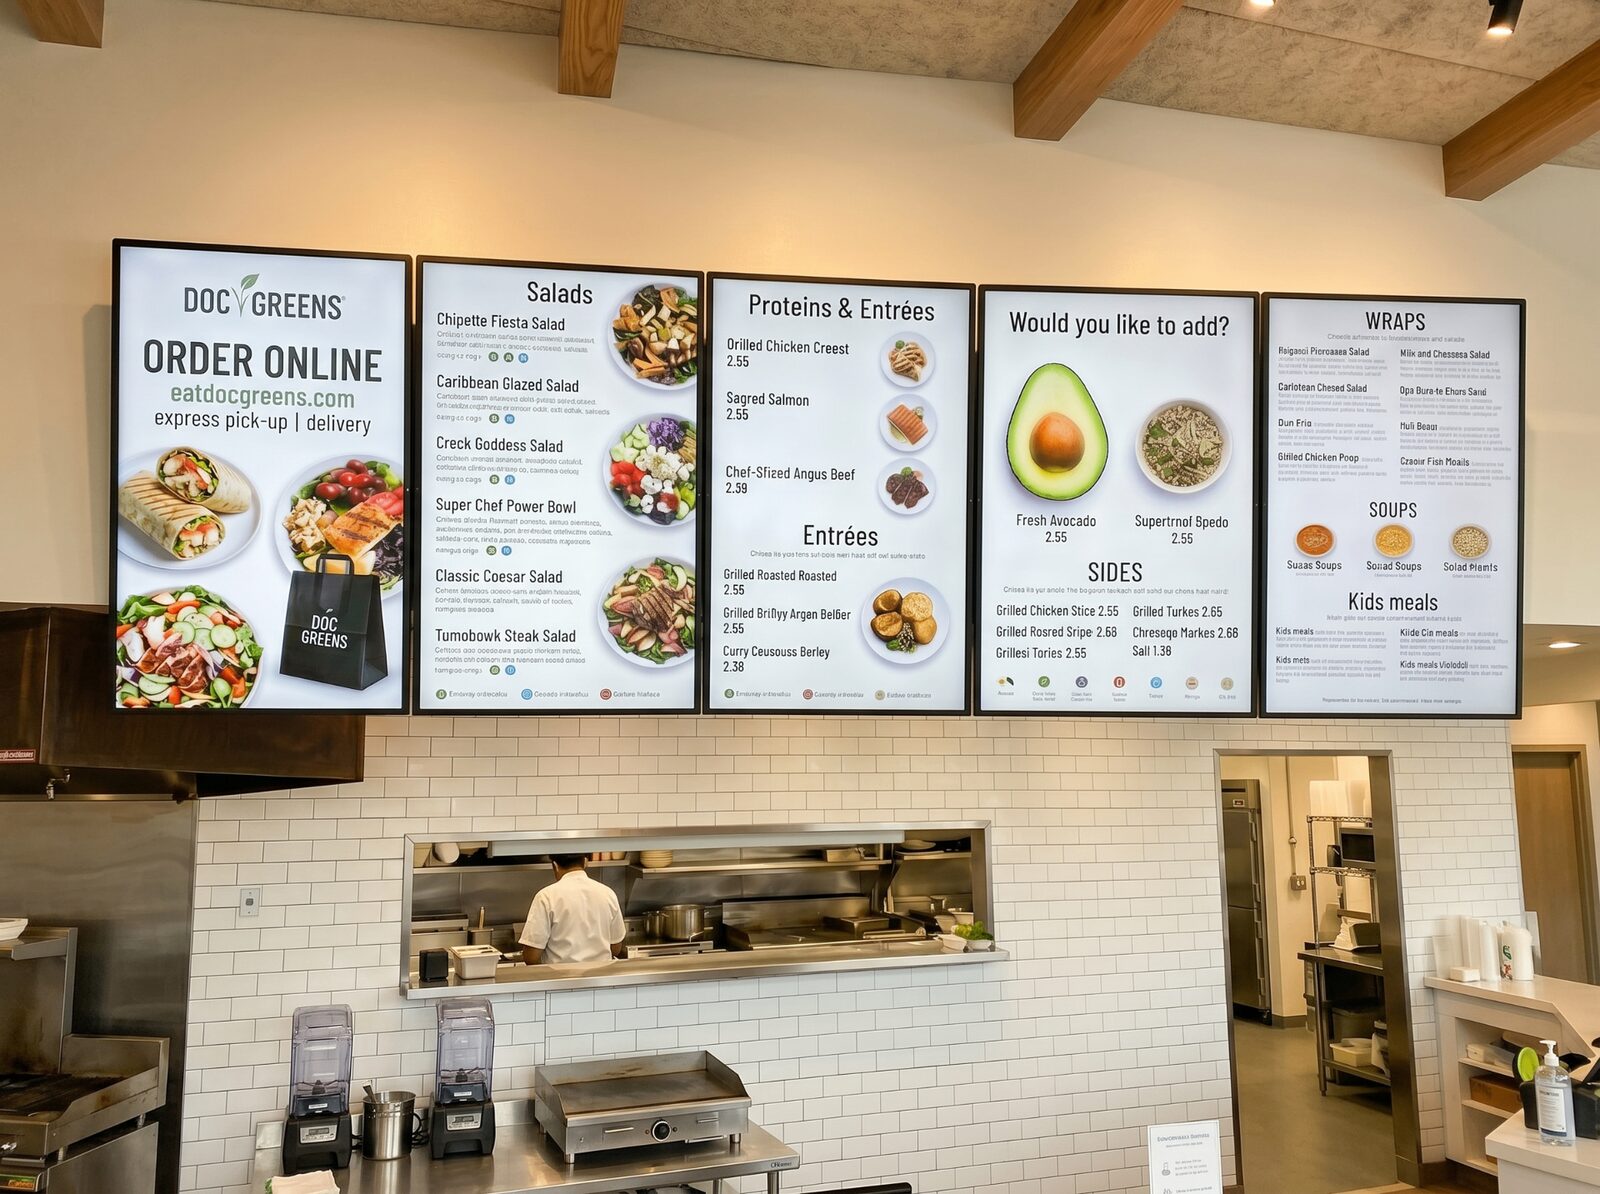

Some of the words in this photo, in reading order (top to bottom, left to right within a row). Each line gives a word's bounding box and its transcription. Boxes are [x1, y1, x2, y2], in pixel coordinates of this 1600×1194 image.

[527, 280, 593, 305] Salads
[184, 286, 231, 315] DOC
[749, 293, 832, 318] Proteins
[838, 297, 853, 319] &
[860, 298, 935, 322] Entrées
[437, 311, 488, 330] Chipette
[491, 314, 529, 330] Fiesta
[531, 316, 565, 331] Salad
[1009, 311, 1069, 333] Would
[1075, 318, 1110, 339] you
[1116, 313, 1151, 335] like
[1156, 316, 1176, 336] to
[1182, 315, 1230, 337] add?
[1365, 311, 1426, 331] WRAPS
[766, 339, 810, 354] Chicken
[813, 341, 850, 355] Creest
[1348, 346, 1370, 357] Salad
[143, 338, 253, 378] ORDER
[264, 344, 383, 383] ONLINE
[726, 354, 750, 368] 2.55
[1417, 349, 1432, 359] and
[1469, 350, 1491, 360] Salad
[436, 374, 499, 390] Caribbean
[502, 376, 543, 392] Glazed
[546, 378, 579, 393] Salad
[1346, 383, 1368, 393] Salad
[170, 383, 355, 410] eatdocgreens.com
[726, 391, 766, 408] Sagred
[768, 392, 810, 407] Salmon
[726, 407, 749, 421] 2.55
[154, 412, 220, 430] express
[225, 410, 288, 434] pick-up
[306, 413, 372, 438] delivery
[436, 435, 472, 450] Creck
[475, 436, 527, 452] Goddess
[530, 438, 563, 453] Salad
[1304, 452, 1338, 462] Chicken
[793, 467, 828, 483] Angus
[830, 467, 856, 481] Beef
[725, 481, 748, 494] 2.59
[436, 497, 473, 515] Super
[475, 498, 503, 512] Chef
[506, 498, 545, 513] Power
[547, 499, 576, 514] Bowl
[1369, 501, 1417, 519] SOUPS
[1016, 513, 1047, 527] Fresh
[1049, 514, 1097, 527] Avocado
[803, 524, 879, 547] Entrées
[1045, 530, 1068, 543] 2.55
[1088, 561, 1143, 583] SIDES
[1315, 560, 1343, 572] Soups
[1395, 560, 1422, 573] Soups
[435, 568, 480, 583] Classic
[483, 569, 527, 584] Coesar
[529, 569, 563, 584] Salad
[723, 568, 755, 581] Grilled
[757, 568, 796, 581] Roasted
[798, 569, 837, 582] Roasted
[723, 583, 745, 596] 2.55
[1348, 591, 1384, 611] Kids
[1389, 592, 1438, 612] meals
[723, 606, 754, 619] Grilled
[996, 604, 1028, 617] Grilled
[1029, 604, 1069, 617] Chicken
[1071, 604, 1096, 617] Stice
[1098, 605, 1119, 617] 2.55
[1132, 605, 1164, 618] Grilled
[1166, 605, 1200, 618] Turkes
[1201, 605, 1223, 618] 2.65
[310, 614, 338, 634] DOC
[723, 622, 745, 634] 2.55
[1275, 626, 1292, 636] Kids
[1292, 627, 1314, 636] meals
[301, 628, 348, 649] GREENS
[435, 628, 501, 643] Tumobowk
[504, 628, 540, 643] Steak
[542, 629, 576, 643] Salad
[996, 625, 1028, 638] Grilled
[1030, 625, 1064, 638] Rosred
[1180, 626, 1216, 639] Markes
[1435, 628, 1459, 638] meals
[722, 645, 750, 660] Curry
[751, 645, 798, 658] Ceusouss
[800, 646, 831, 661] Berley
[995, 646, 1030, 659] Grillesi
[1031, 646, 1063, 659] Tories
[1065, 647, 1087, 659] 2.55
[1152, 645, 1172, 657] 1.38
[723, 660, 745, 673] 2.38
[1275, 655, 1292, 664] Kids
[1292, 656, 1311, 665] mets
[1399, 660, 1416, 669] Kids
[1416, 660, 1439, 669] meals
